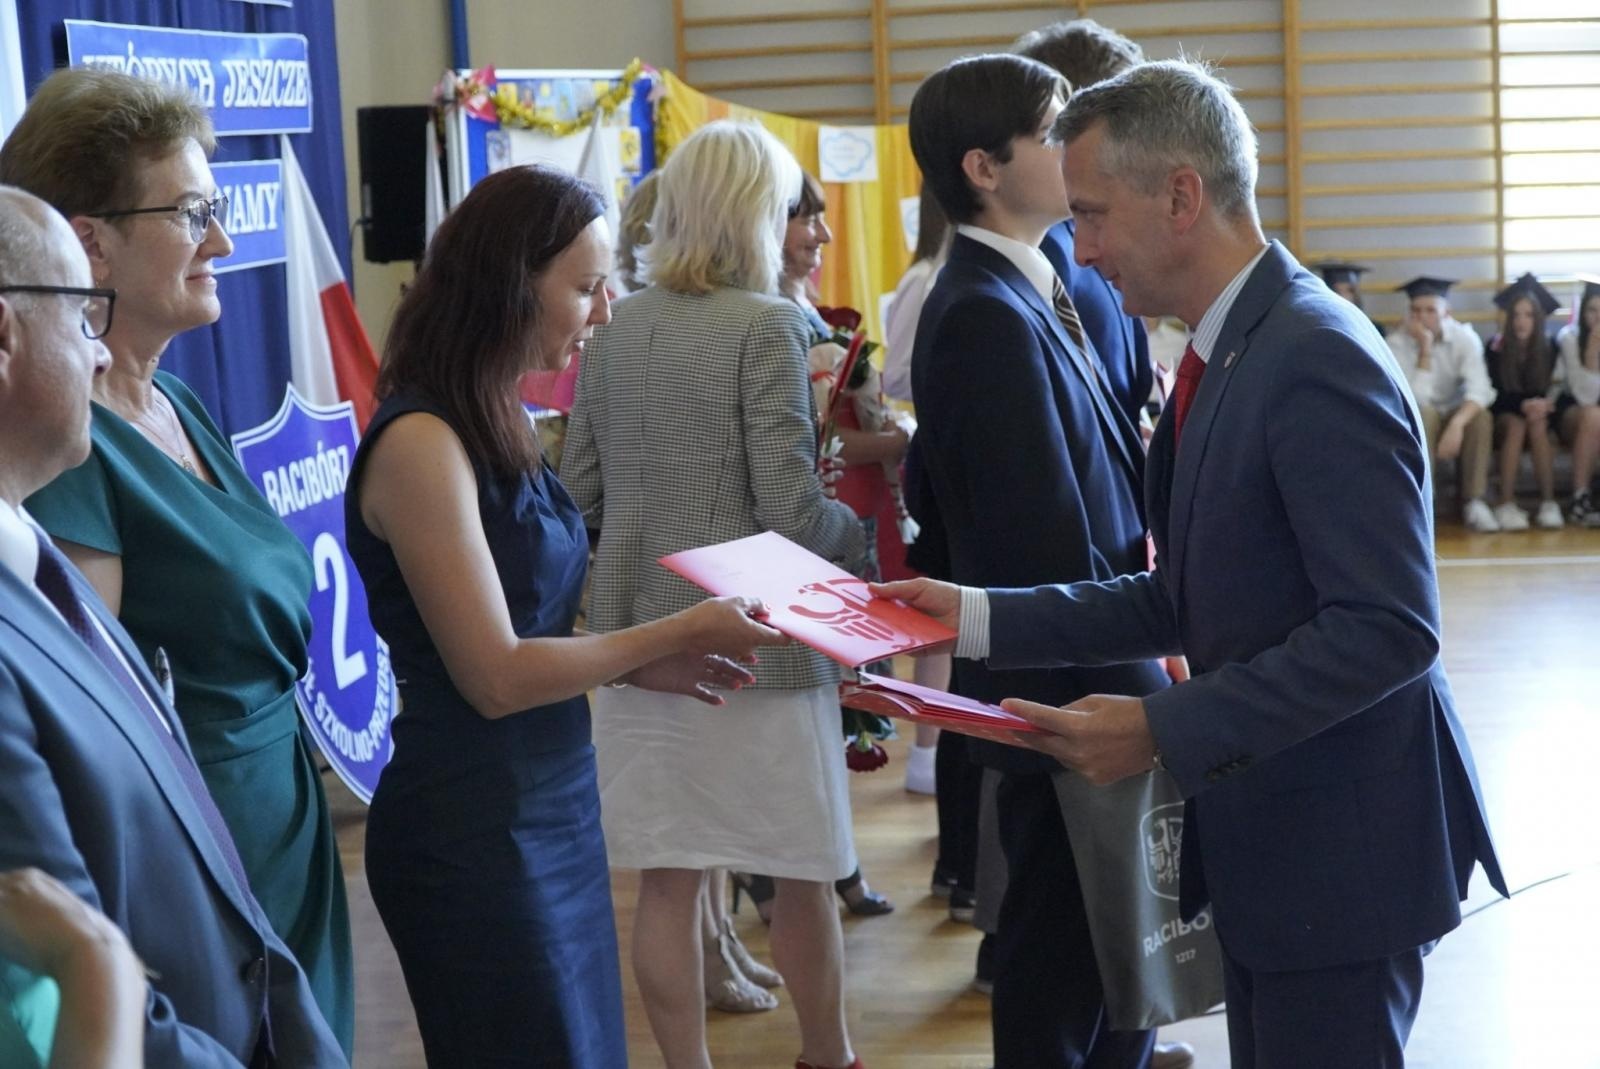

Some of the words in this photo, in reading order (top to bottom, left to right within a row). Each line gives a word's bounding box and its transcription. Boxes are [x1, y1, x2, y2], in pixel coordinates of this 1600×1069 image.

[221, 59, 307, 108] JESZCZE
[262, 440, 349, 518] RACIBÓRZ
[313, 532, 368, 690] 2
[1175, 948, 1197, 964] 1217
